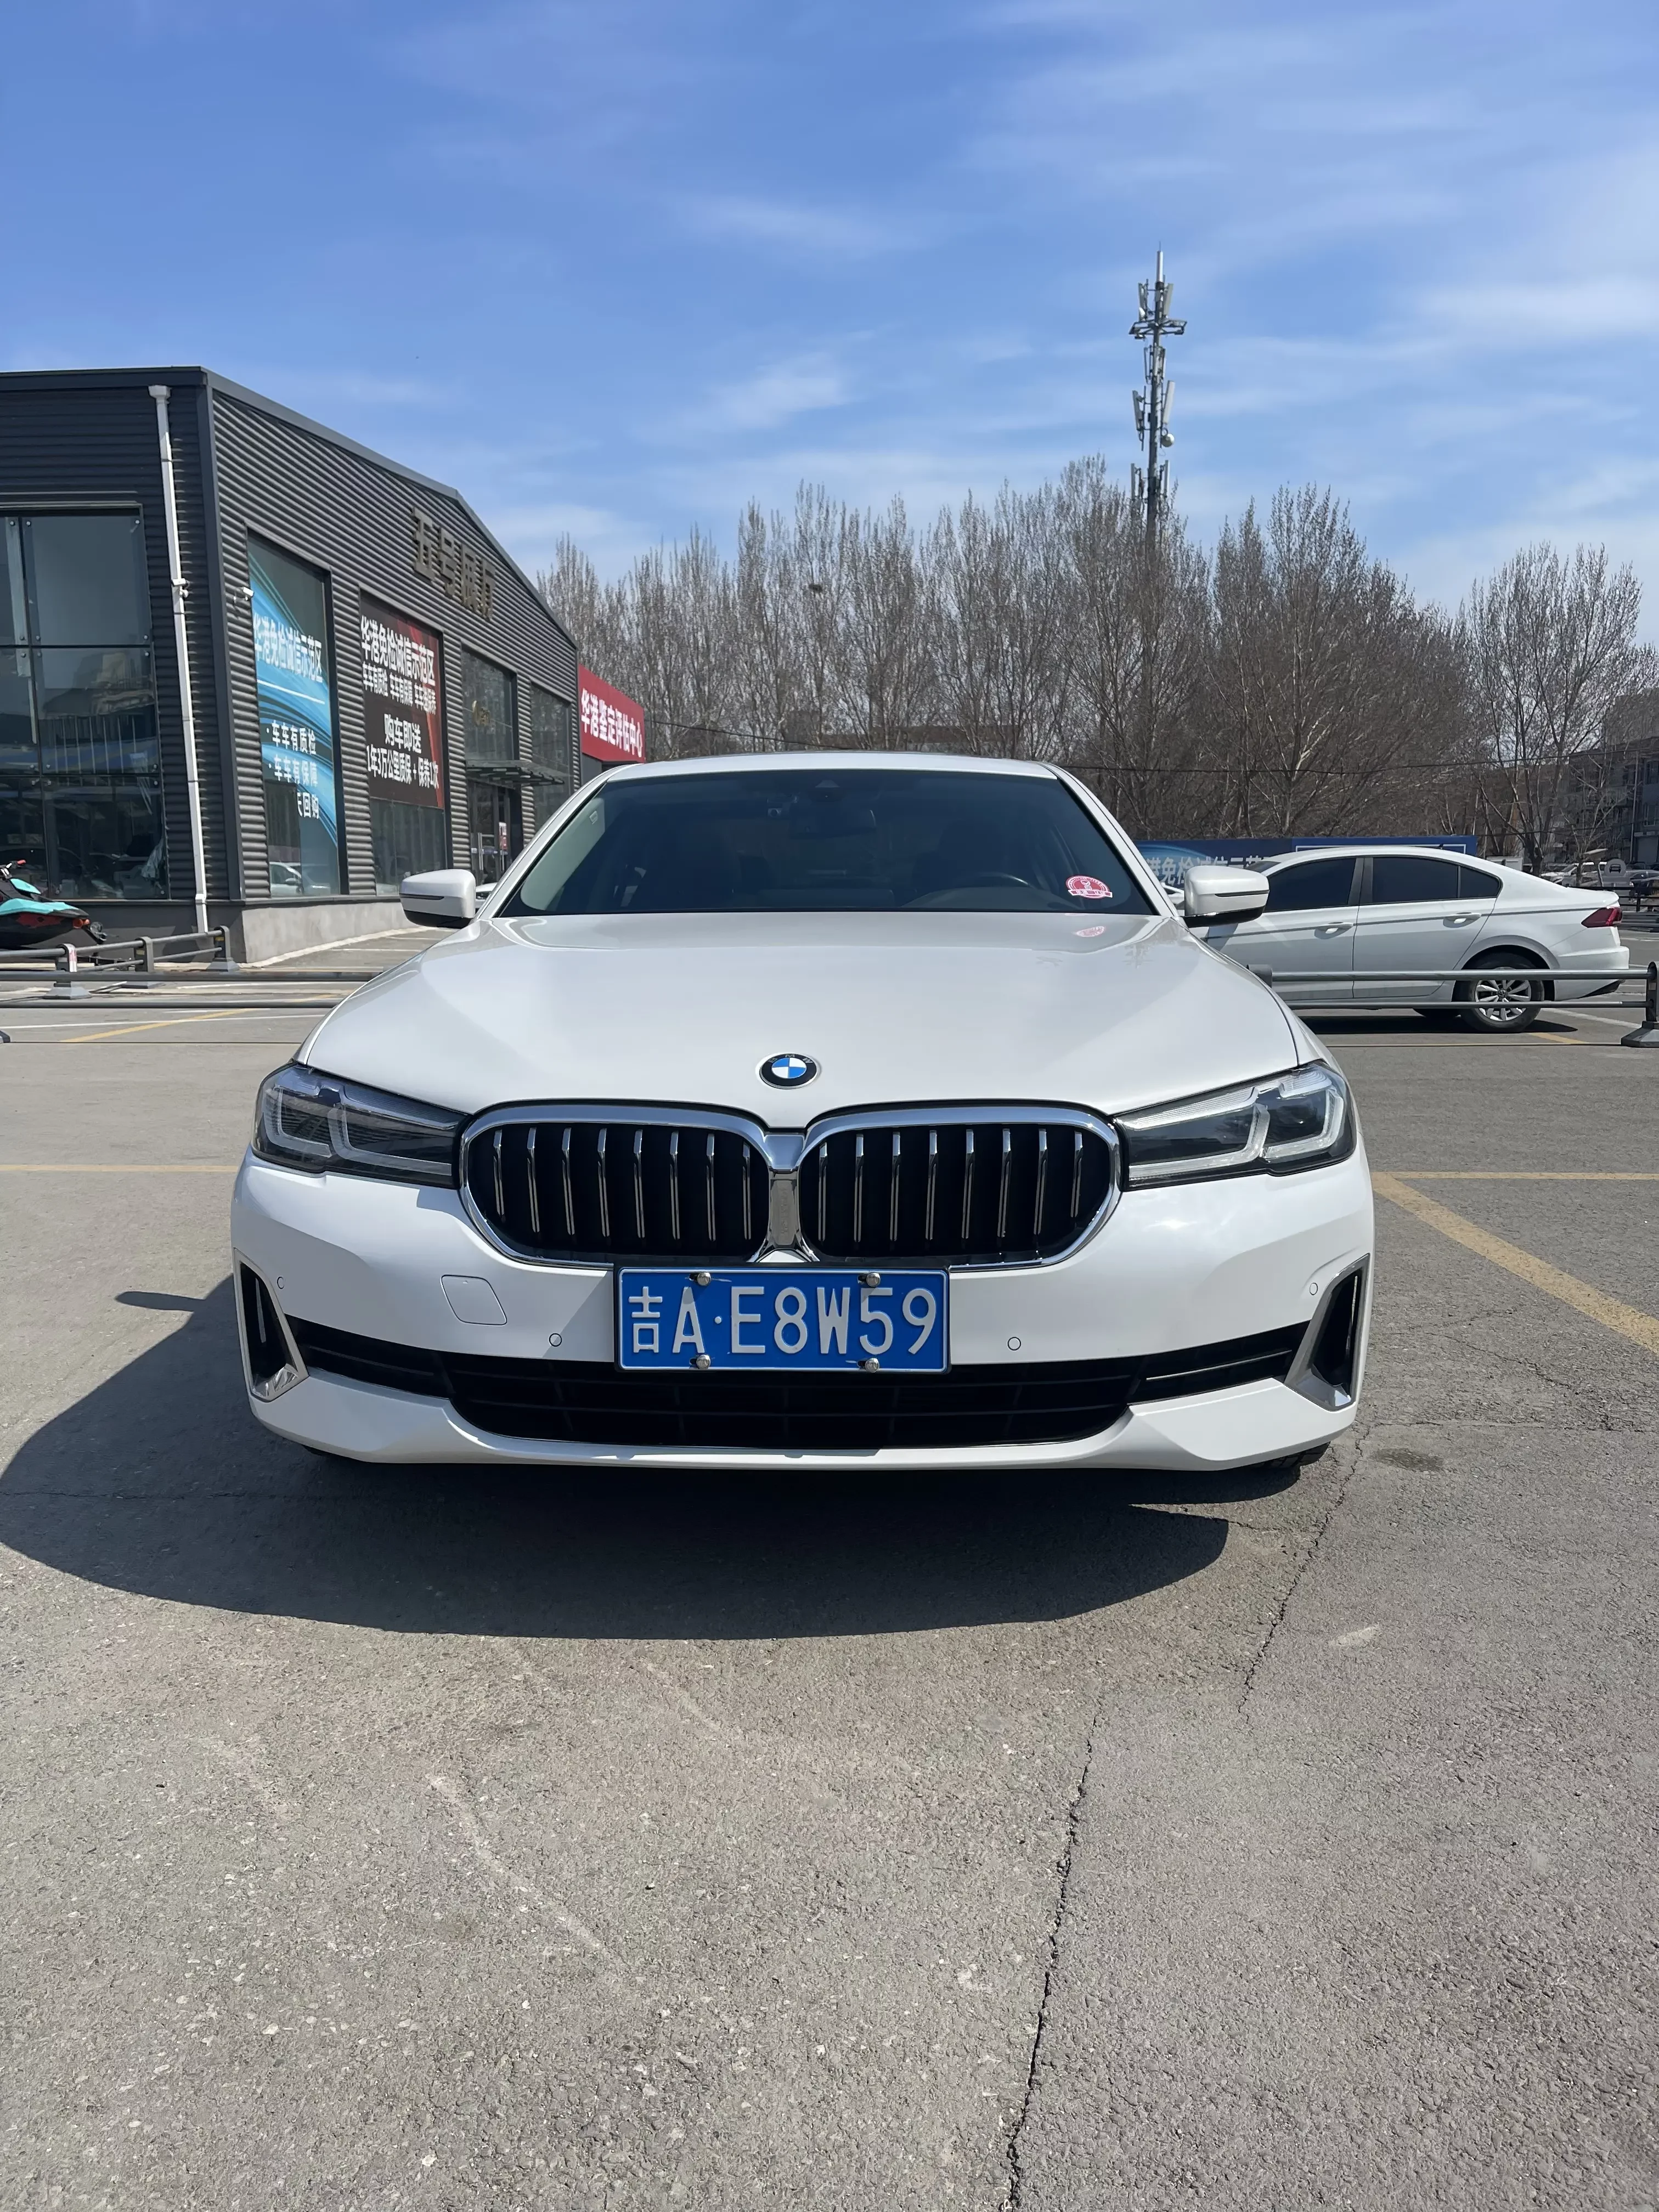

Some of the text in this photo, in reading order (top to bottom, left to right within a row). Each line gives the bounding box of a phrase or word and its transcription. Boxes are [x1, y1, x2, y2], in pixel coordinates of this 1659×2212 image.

[360, 614, 436, 686] 华港免检诚信示范区
[271, 719, 317, 755] 车车有质检
[384, 713, 422, 754] 购车即送
[581, 687, 643, 758] 华港鉴定评估中心
[274, 754, 318, 787] 车车有保障
[768, 1054, 813, 1063] BMW
